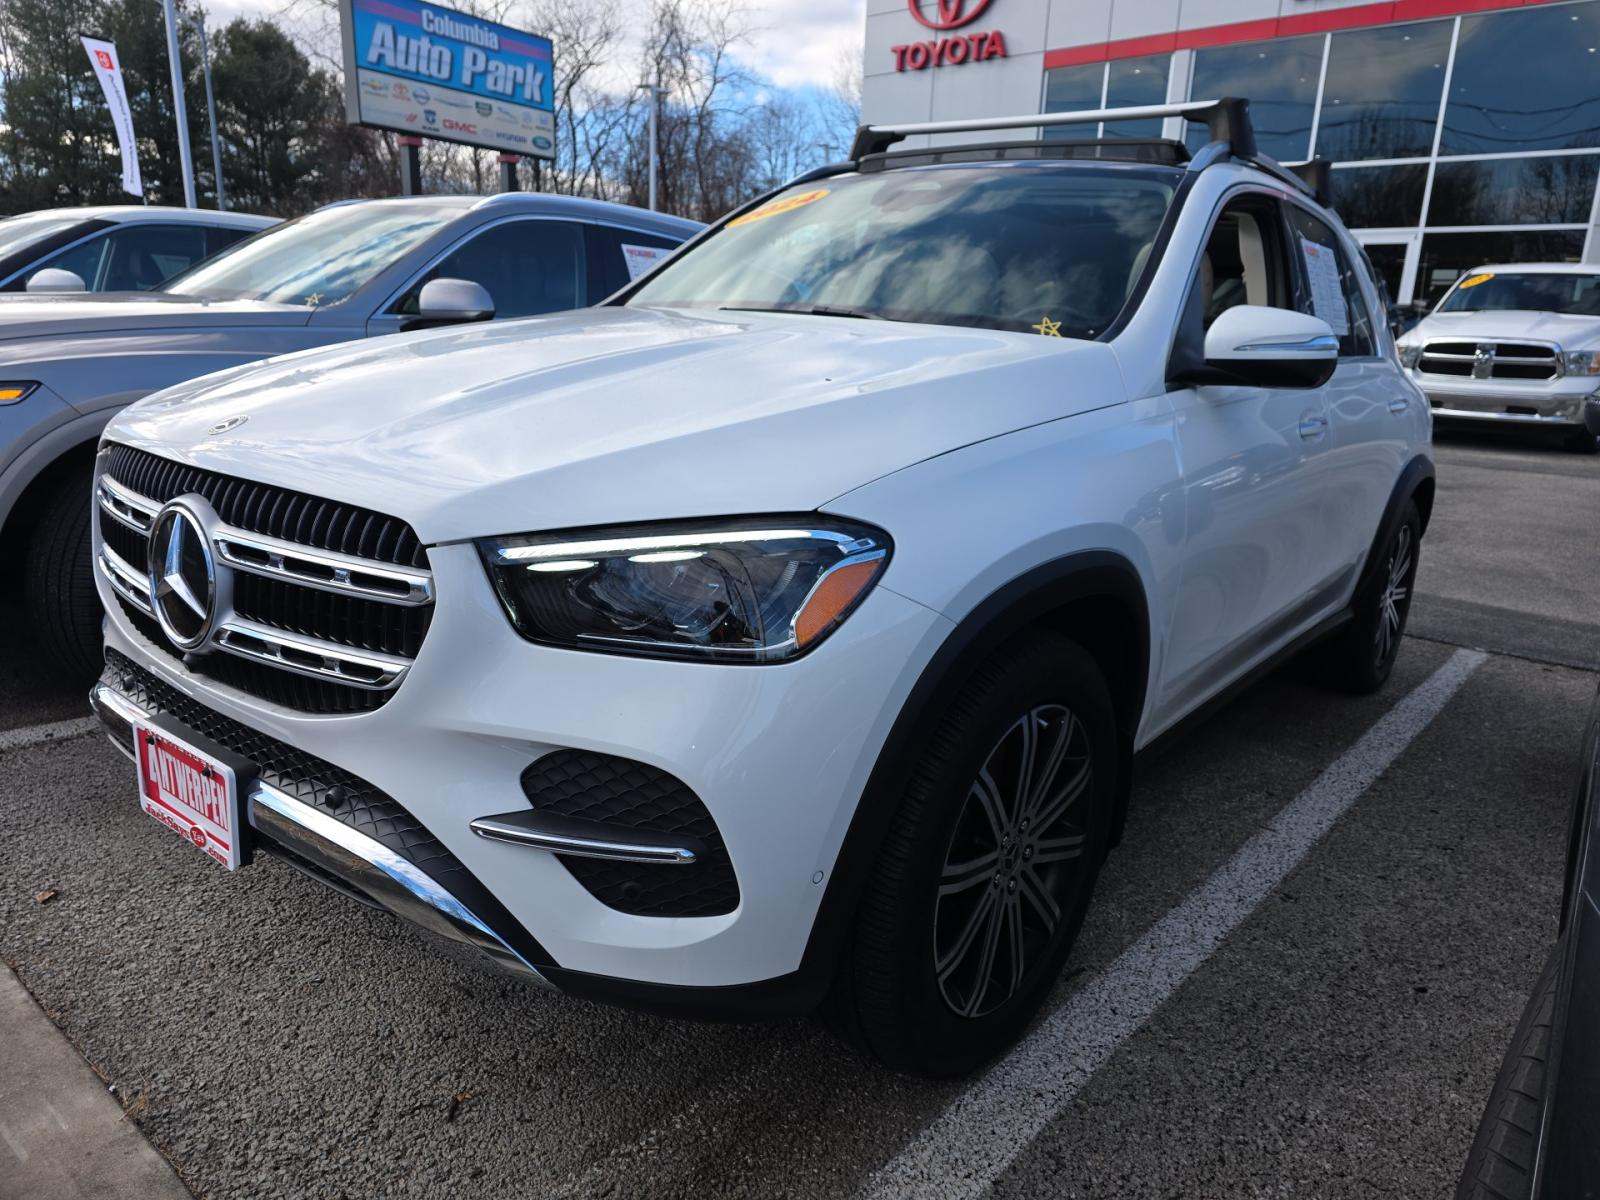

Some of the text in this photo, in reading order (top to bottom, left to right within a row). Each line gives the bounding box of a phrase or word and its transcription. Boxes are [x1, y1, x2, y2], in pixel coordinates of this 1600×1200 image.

[421, 9, 499, 50] Columbia
[367, 21, 544, 103] Auto Park
[891, 30, 1007, 72] TOYOTA
[442, 118, 477, 135] GMC
[148, 745, 229, 832] ANTWERPEN
